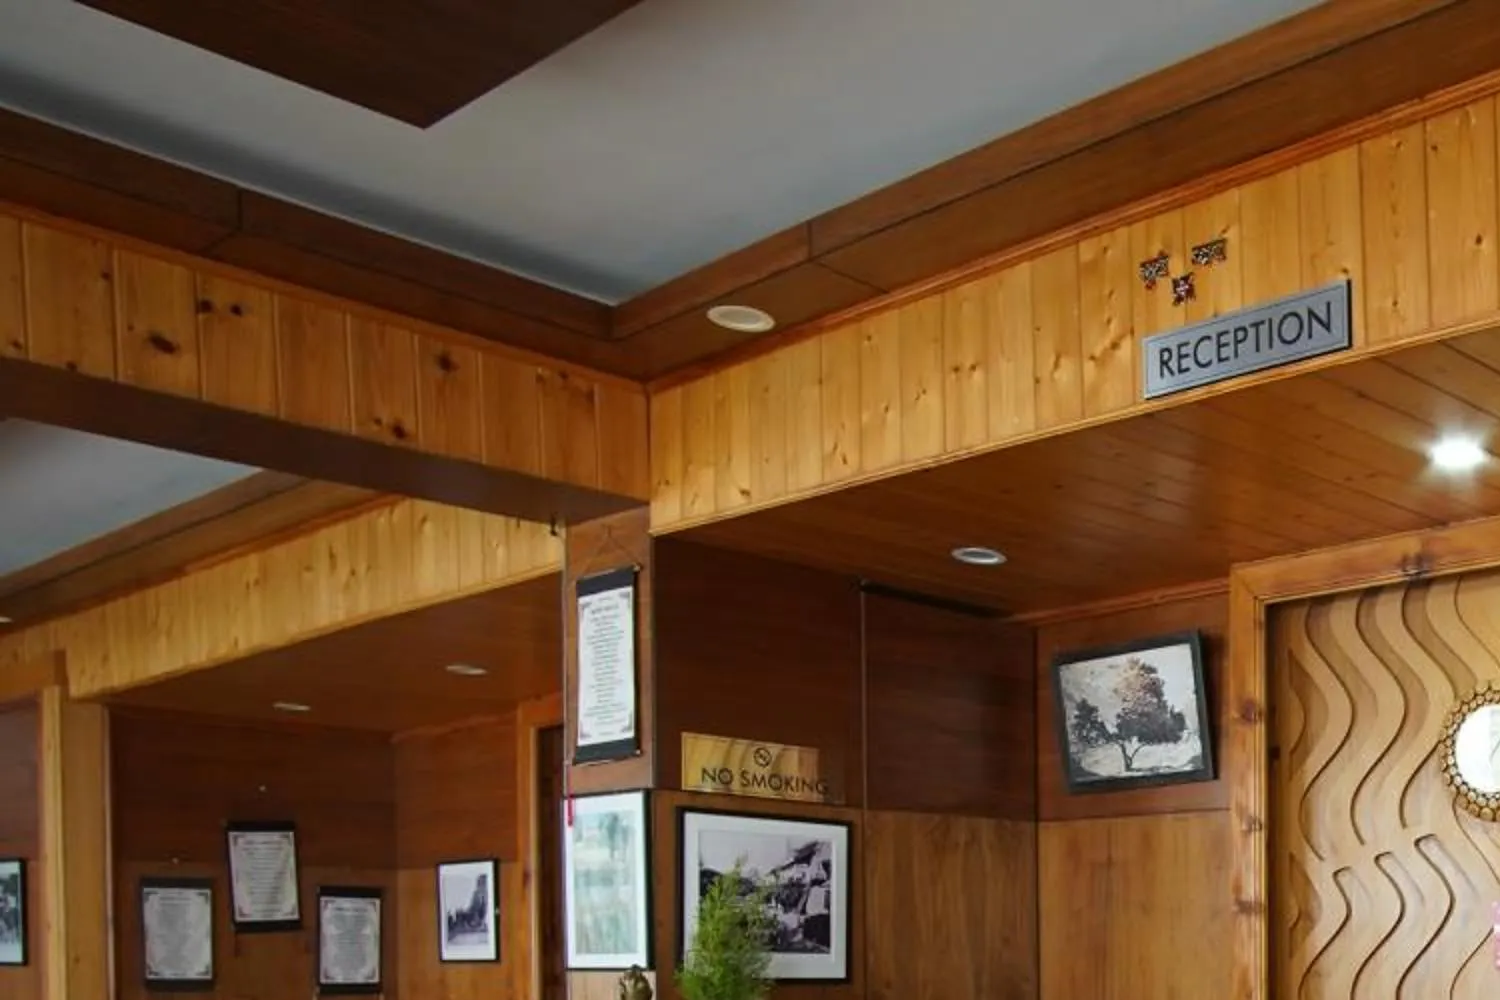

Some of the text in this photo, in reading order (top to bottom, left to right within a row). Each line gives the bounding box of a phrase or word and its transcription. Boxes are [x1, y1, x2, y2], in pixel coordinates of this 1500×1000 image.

[1158, 301, 1333, 379] RECEPTION
[701, 767, 829, 795] NO SMOKING
